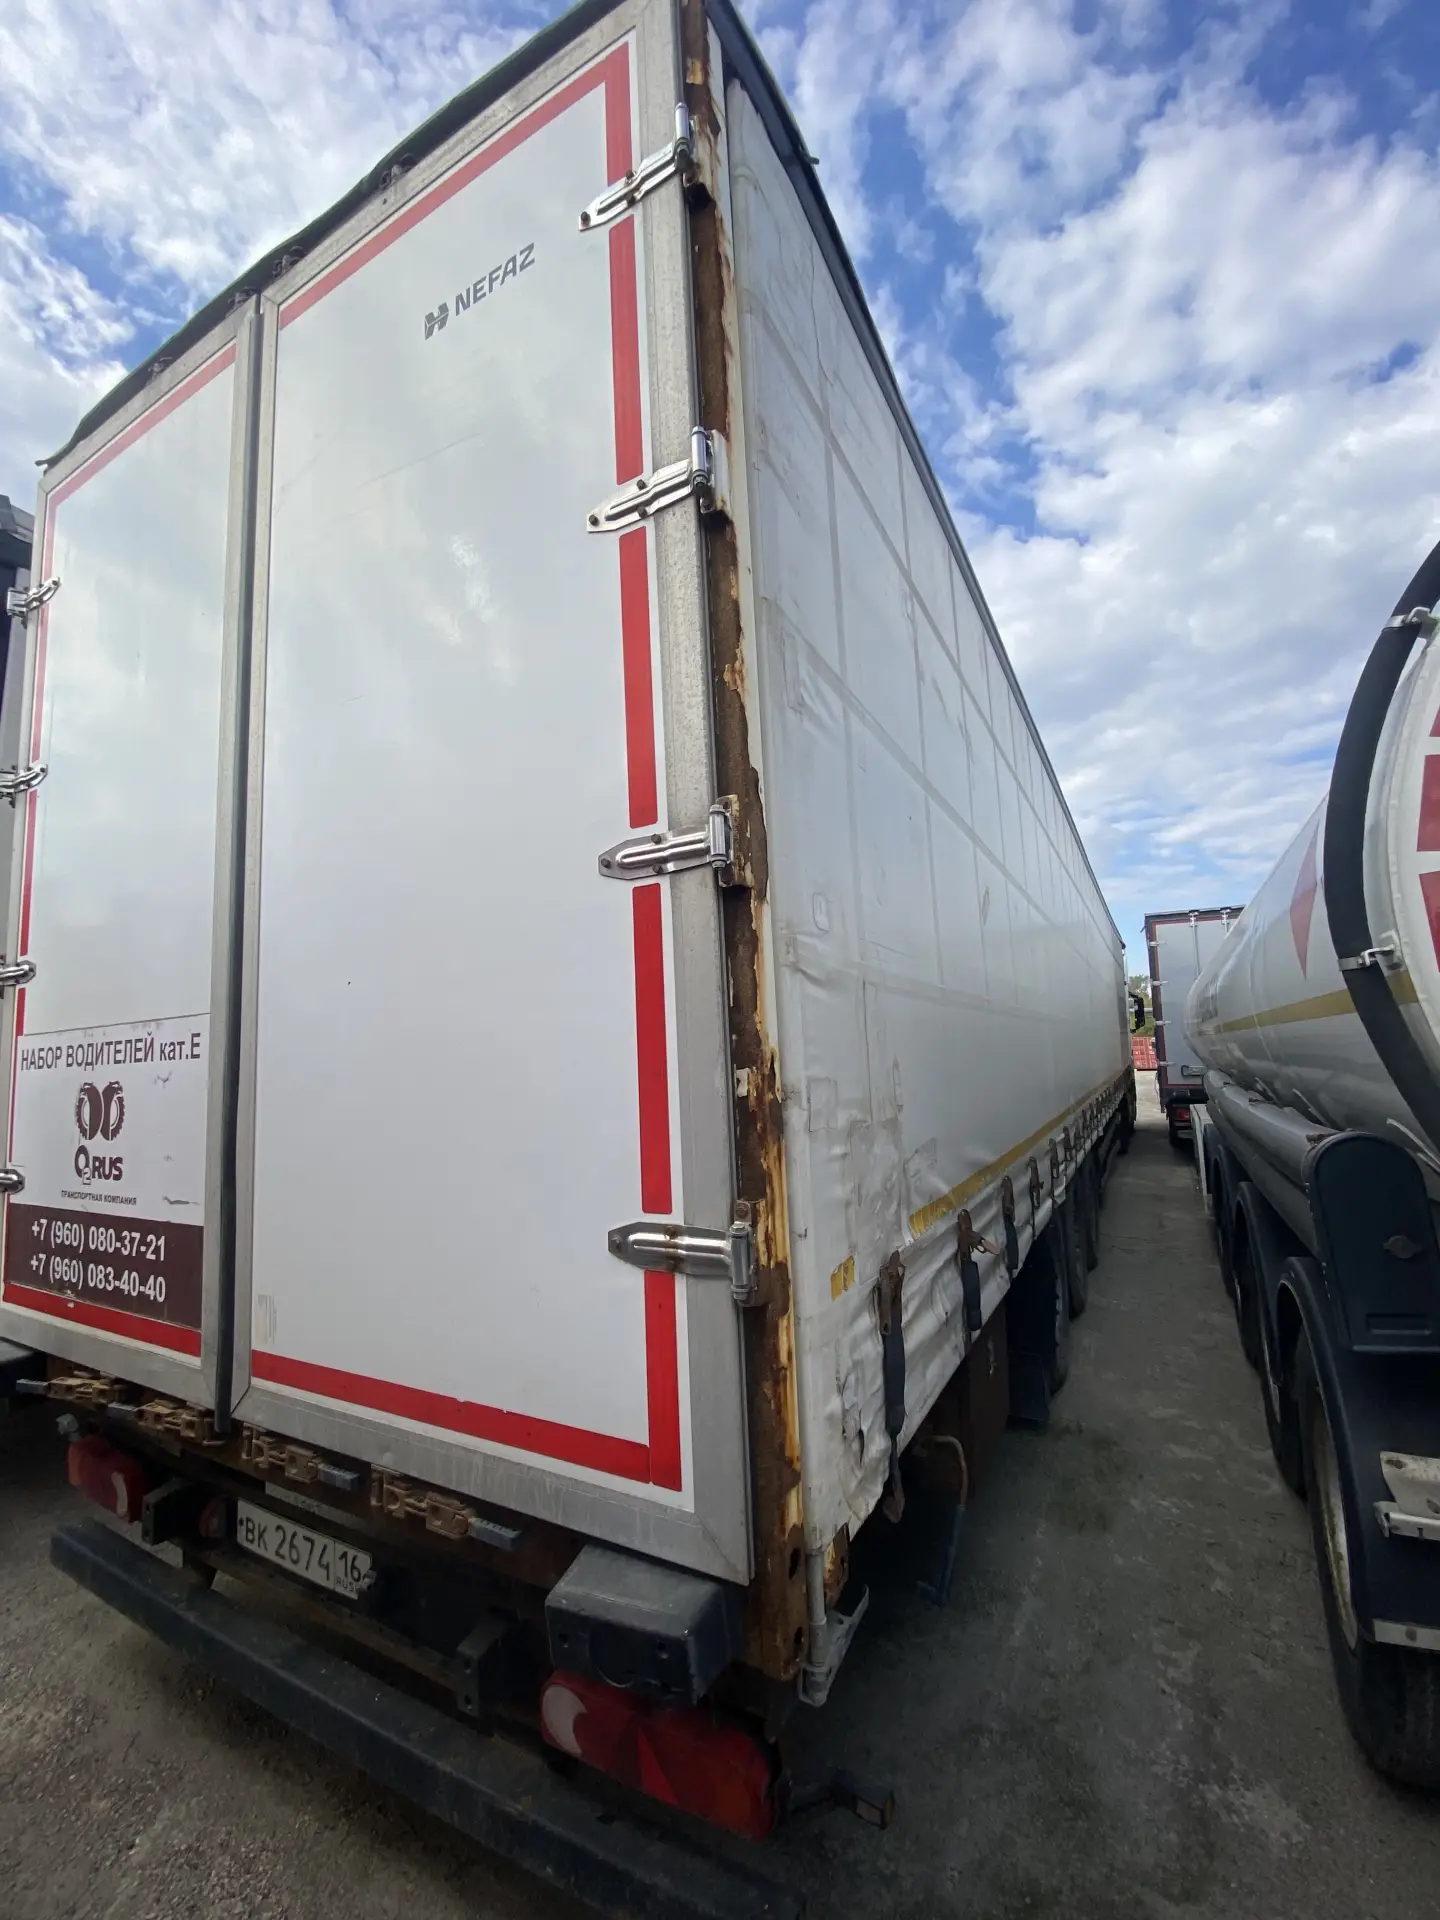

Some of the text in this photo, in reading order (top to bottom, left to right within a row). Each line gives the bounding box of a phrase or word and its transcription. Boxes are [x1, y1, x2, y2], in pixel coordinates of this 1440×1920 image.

[455, 242, 536, 317] NEFAZ
[20, 1046, 63, 1071] НАБОР
[65, 1031, 155, 1072] ВОДИТЕЛЕЙ
[61, 1189, 137, 1206] ТРАНСПОРТНАЯ КОМПАНИЯ
[31, 1219, 167, 1262] +7 (960) 080-37-21
[30, 1253, 167, 1304] +7 (960) 083-40-40
[336, 1576, 355, 1593] RUS
